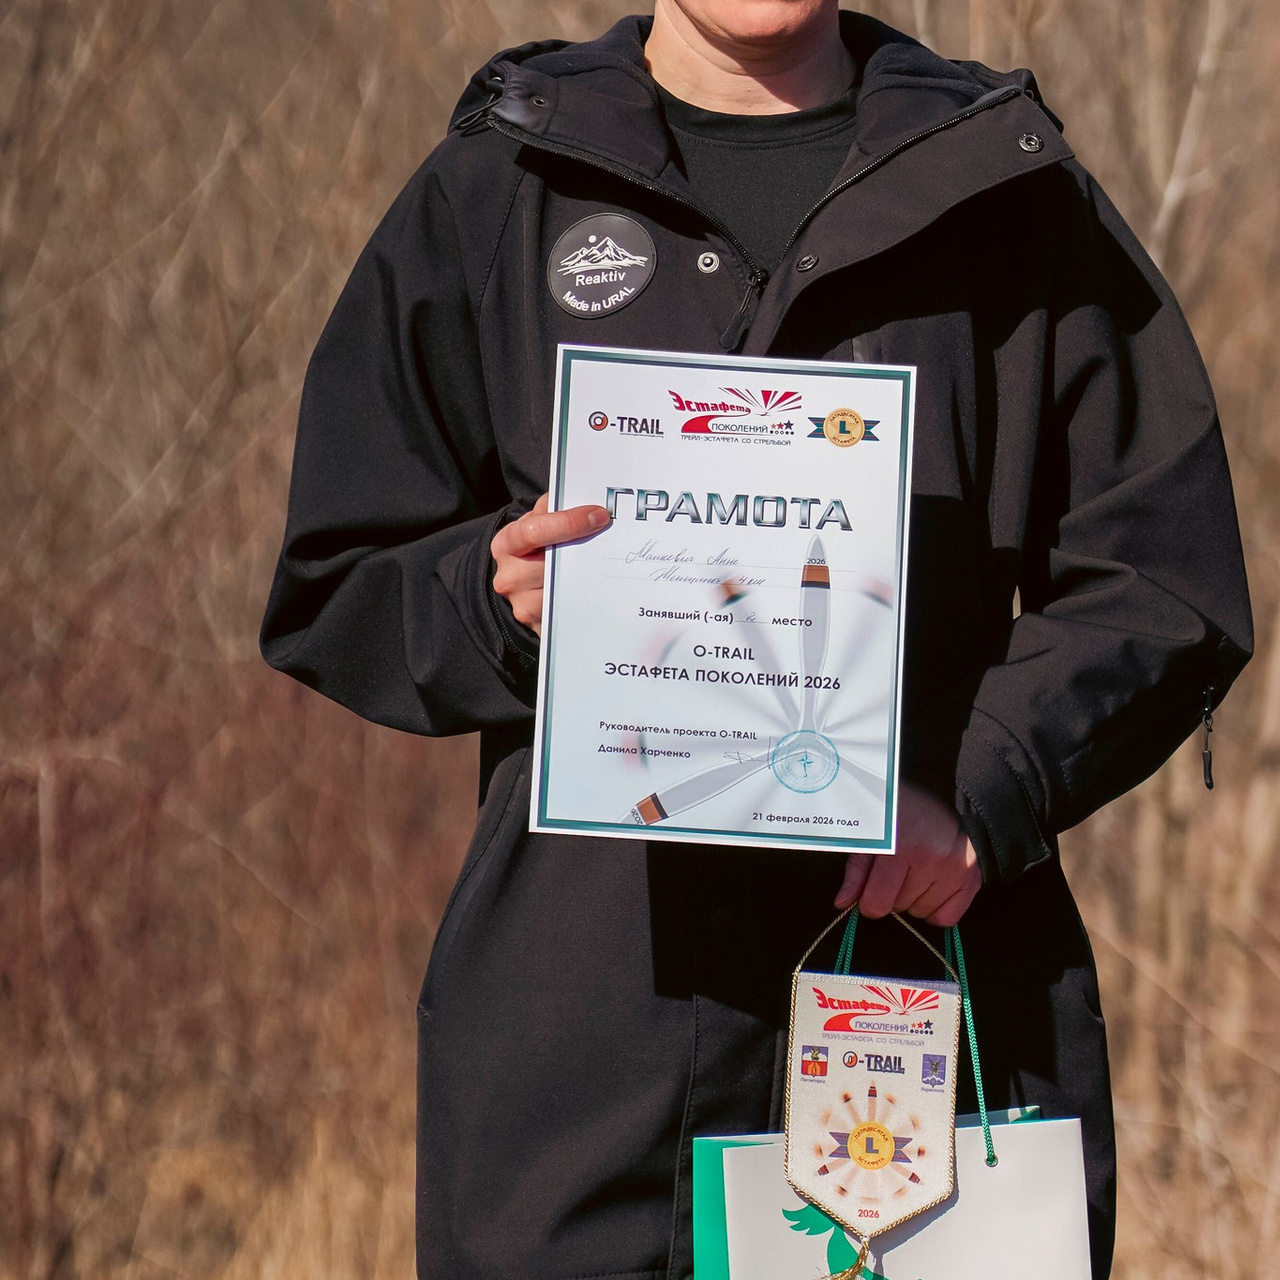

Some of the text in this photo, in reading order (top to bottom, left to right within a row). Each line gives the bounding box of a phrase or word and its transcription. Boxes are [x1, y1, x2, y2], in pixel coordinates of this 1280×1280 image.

[575, 270, 626, 287] Reaktiv
[562, 286, 635, 312] Made in URAL
[668, 389, 752, 413] Эстафета
[711, 422, 768, 433] ПОКОЛЕНИЙ
[839, 420, 851, 435] L
[681, 434, 739, 443] ТРЕЙЛ-ЭСТАФЕТА
[606, 486, 853, 531] ГРАМОТА
[638, 607, 700, 621] Занявший
[703, 611, 734, 625] (-ая)
[772, 616, 813, 627] место
[693, 644, 755, 661] O-TRAIL
[604, 662, 841, 690] ЭСТАФЕТА ПОКОЛЕНИЙ 2026
[599, 721, 757, 740] Руководитель проекта O-TRAIL
[598, 743, 691, 759] Данила Харченко
[752, 813, 860, 827] 21 февраля 2026 года
[812, 986, 891, 1011] Эстафета
[855, 1021, 909, 1033] ПОКОЛЕНИЙ
[865, 1137, 879, 1153] L
[857, 1208, 880, 1219] 2026
